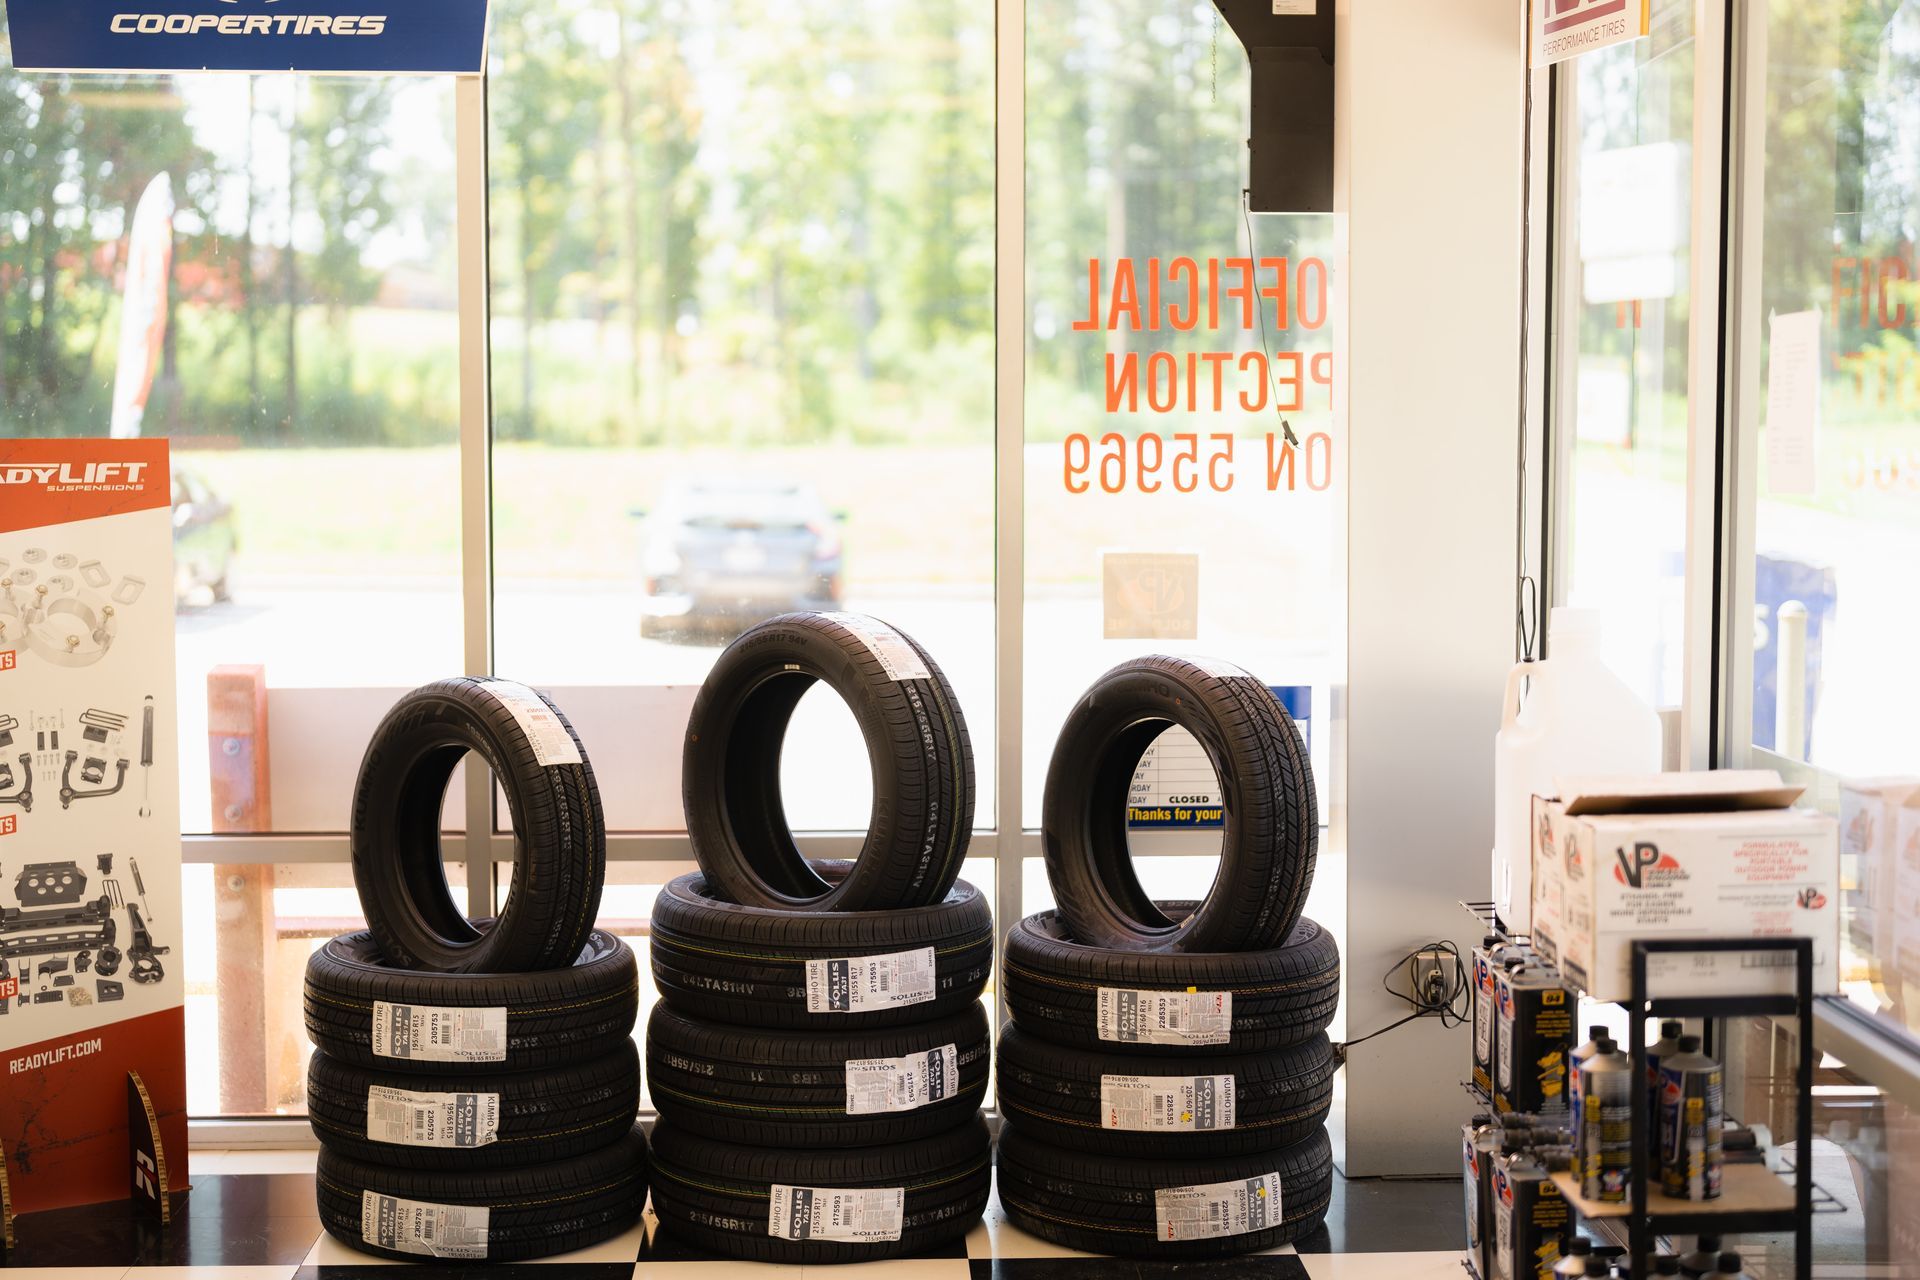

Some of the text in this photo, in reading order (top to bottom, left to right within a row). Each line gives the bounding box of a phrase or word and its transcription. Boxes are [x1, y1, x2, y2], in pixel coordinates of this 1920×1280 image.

[110, 14, 387, 35] COOPERTIRES
[1543, 19, 1625, 56] PERFORMANCE TIRES
[47, 484, 144, 492] SUSPENSIONS
[1128, 807, 1223, 823] Thanks for your
[1169, 795, 1209, 804] CLOSED
[1617, 842, 1659, 888] VP
[810, 963, 819, 1010] KUMHO TIRE
[832, 962, 841, 1009] SOLUS
[851, 980, 859, 1003] 215/55
[869, 962, 877, 993] 2175593
[431, 1013, 439, 1044] 2305753
[1121, 992, 1129, 1039] SOLUS
[1158, 998, 1166, 1029] 2285353
[375, 1023, 383, 1053] KUMHO
[394, 1007, 403, 1055] SOLUS
[412, 1014, 420, 1051] 195/65 R15
[10, 1038, 102, 1075] READYLIFT.COM
[947, 1046, 957, 1094] KUMHO TIRE
[906, 1072, 915, 1102] 2175593
[933, 1051, 942, 1099] SOLUS
[487, 1096, 495, 1126] KUMHO
[1166, 1094, 1174, 1126] 2285353
[1203, 1079, 1211, 1127] SOLUS
[1224, 1108, 1232, 1126] TIRE
[427, 1110, 435, 1141] 2305753
[446, 1102, 454, 1139] 195/65 R15
[464, 1096, 474, 1145] SOLUS
[1255, 1180, 1263, 1229] SOLUS
[1271, 1175, 1279, 1205] KUMHO
[381, 1198, 389, 1246] SOLUS
[414, 1207, 423, 1238] 2305753
[773, 1187, 783, 1236] KUMHO TIRE
[793, 1189, 803, 1238] SOLUS
[812, 1197, 822, 1234] 215/55 R17
[832, 1195, 841, 1226] 2175593
[1222, 1200, 1230, 1231] 2285353
